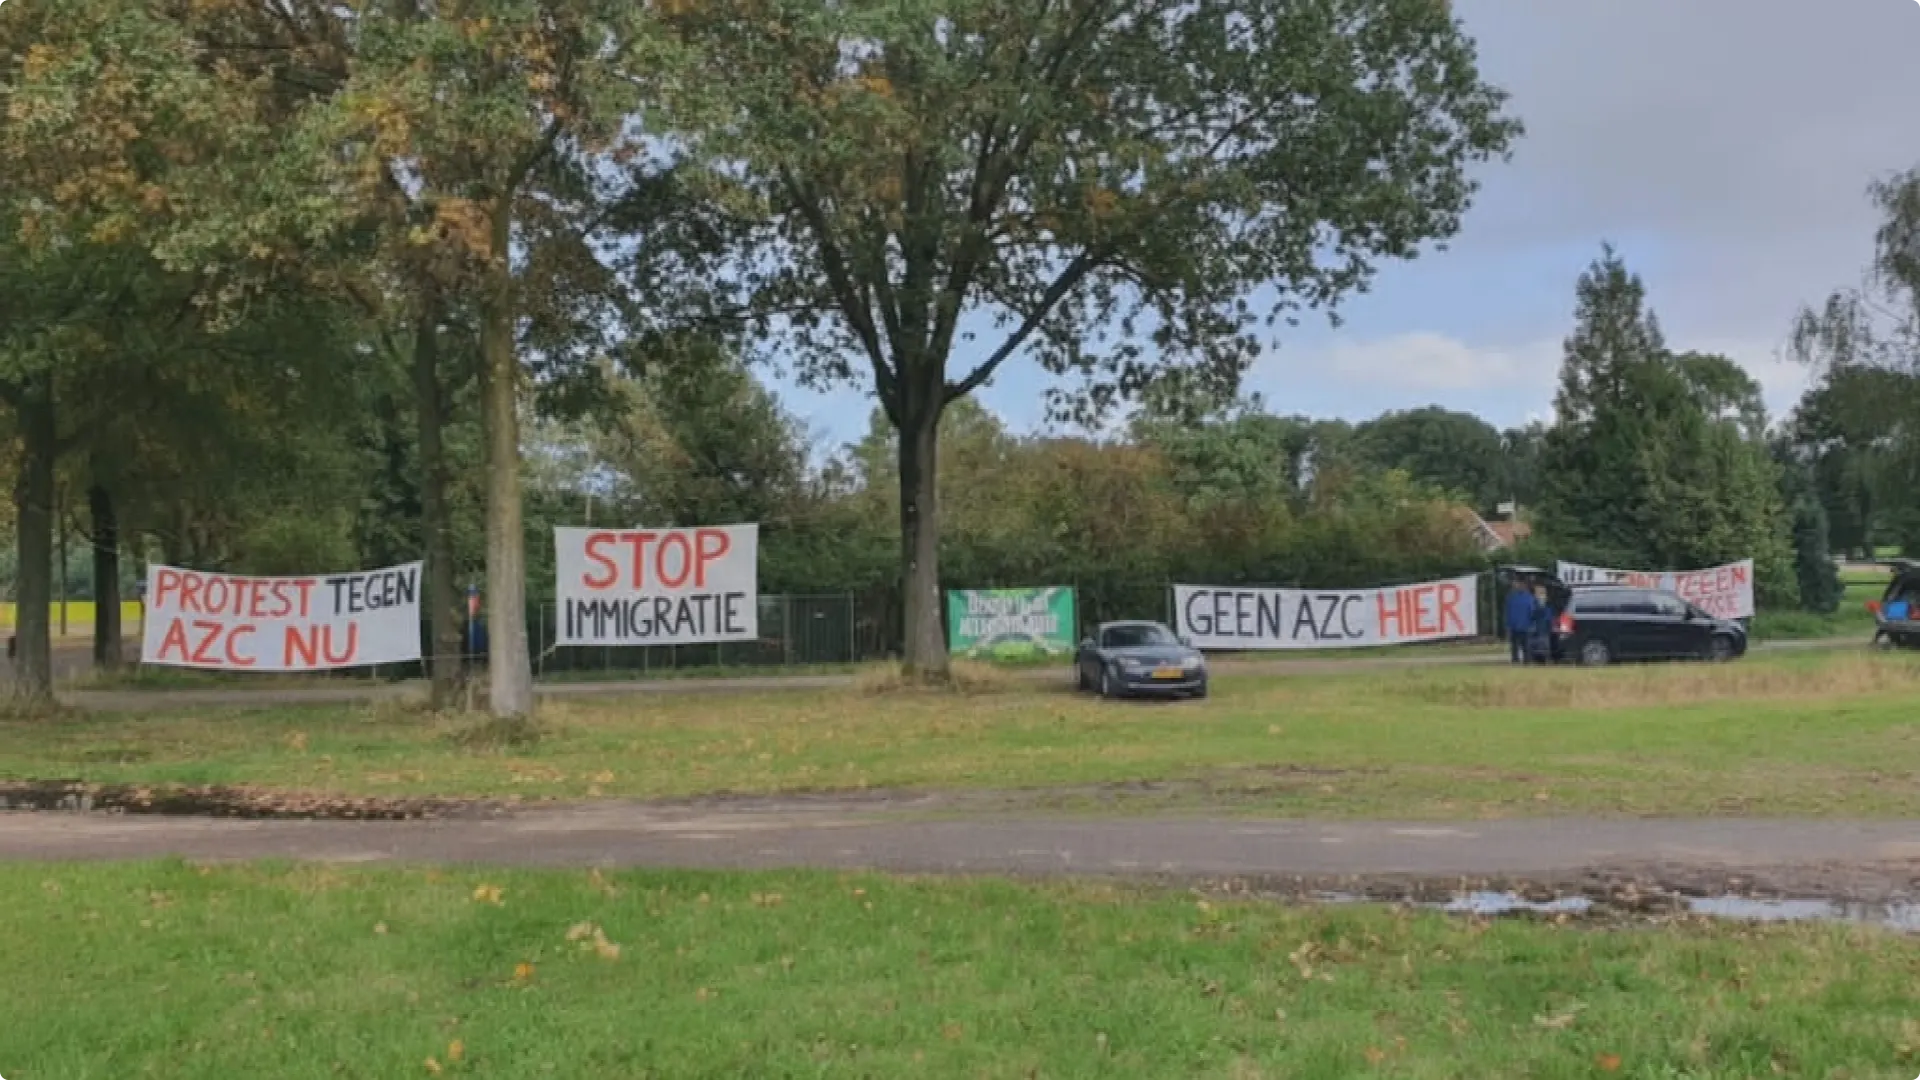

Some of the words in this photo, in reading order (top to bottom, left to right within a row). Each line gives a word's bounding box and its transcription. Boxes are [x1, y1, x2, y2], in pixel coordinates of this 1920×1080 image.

[583, 528, 730, 589] STOP
[155, 569, 317, 617] PROTEST
[326, 568, 416, 614] TEGEN
[566, 591, 746, 639] IMMIGRATIE
[1185, 590, 1281, 639] GEEN
[1292, 594, 1364, 640] AZC
[1376, 583, 1465, 637] HIER
[157, 616, 256, 664] AZC
[284, 621, 358, 667] NU
